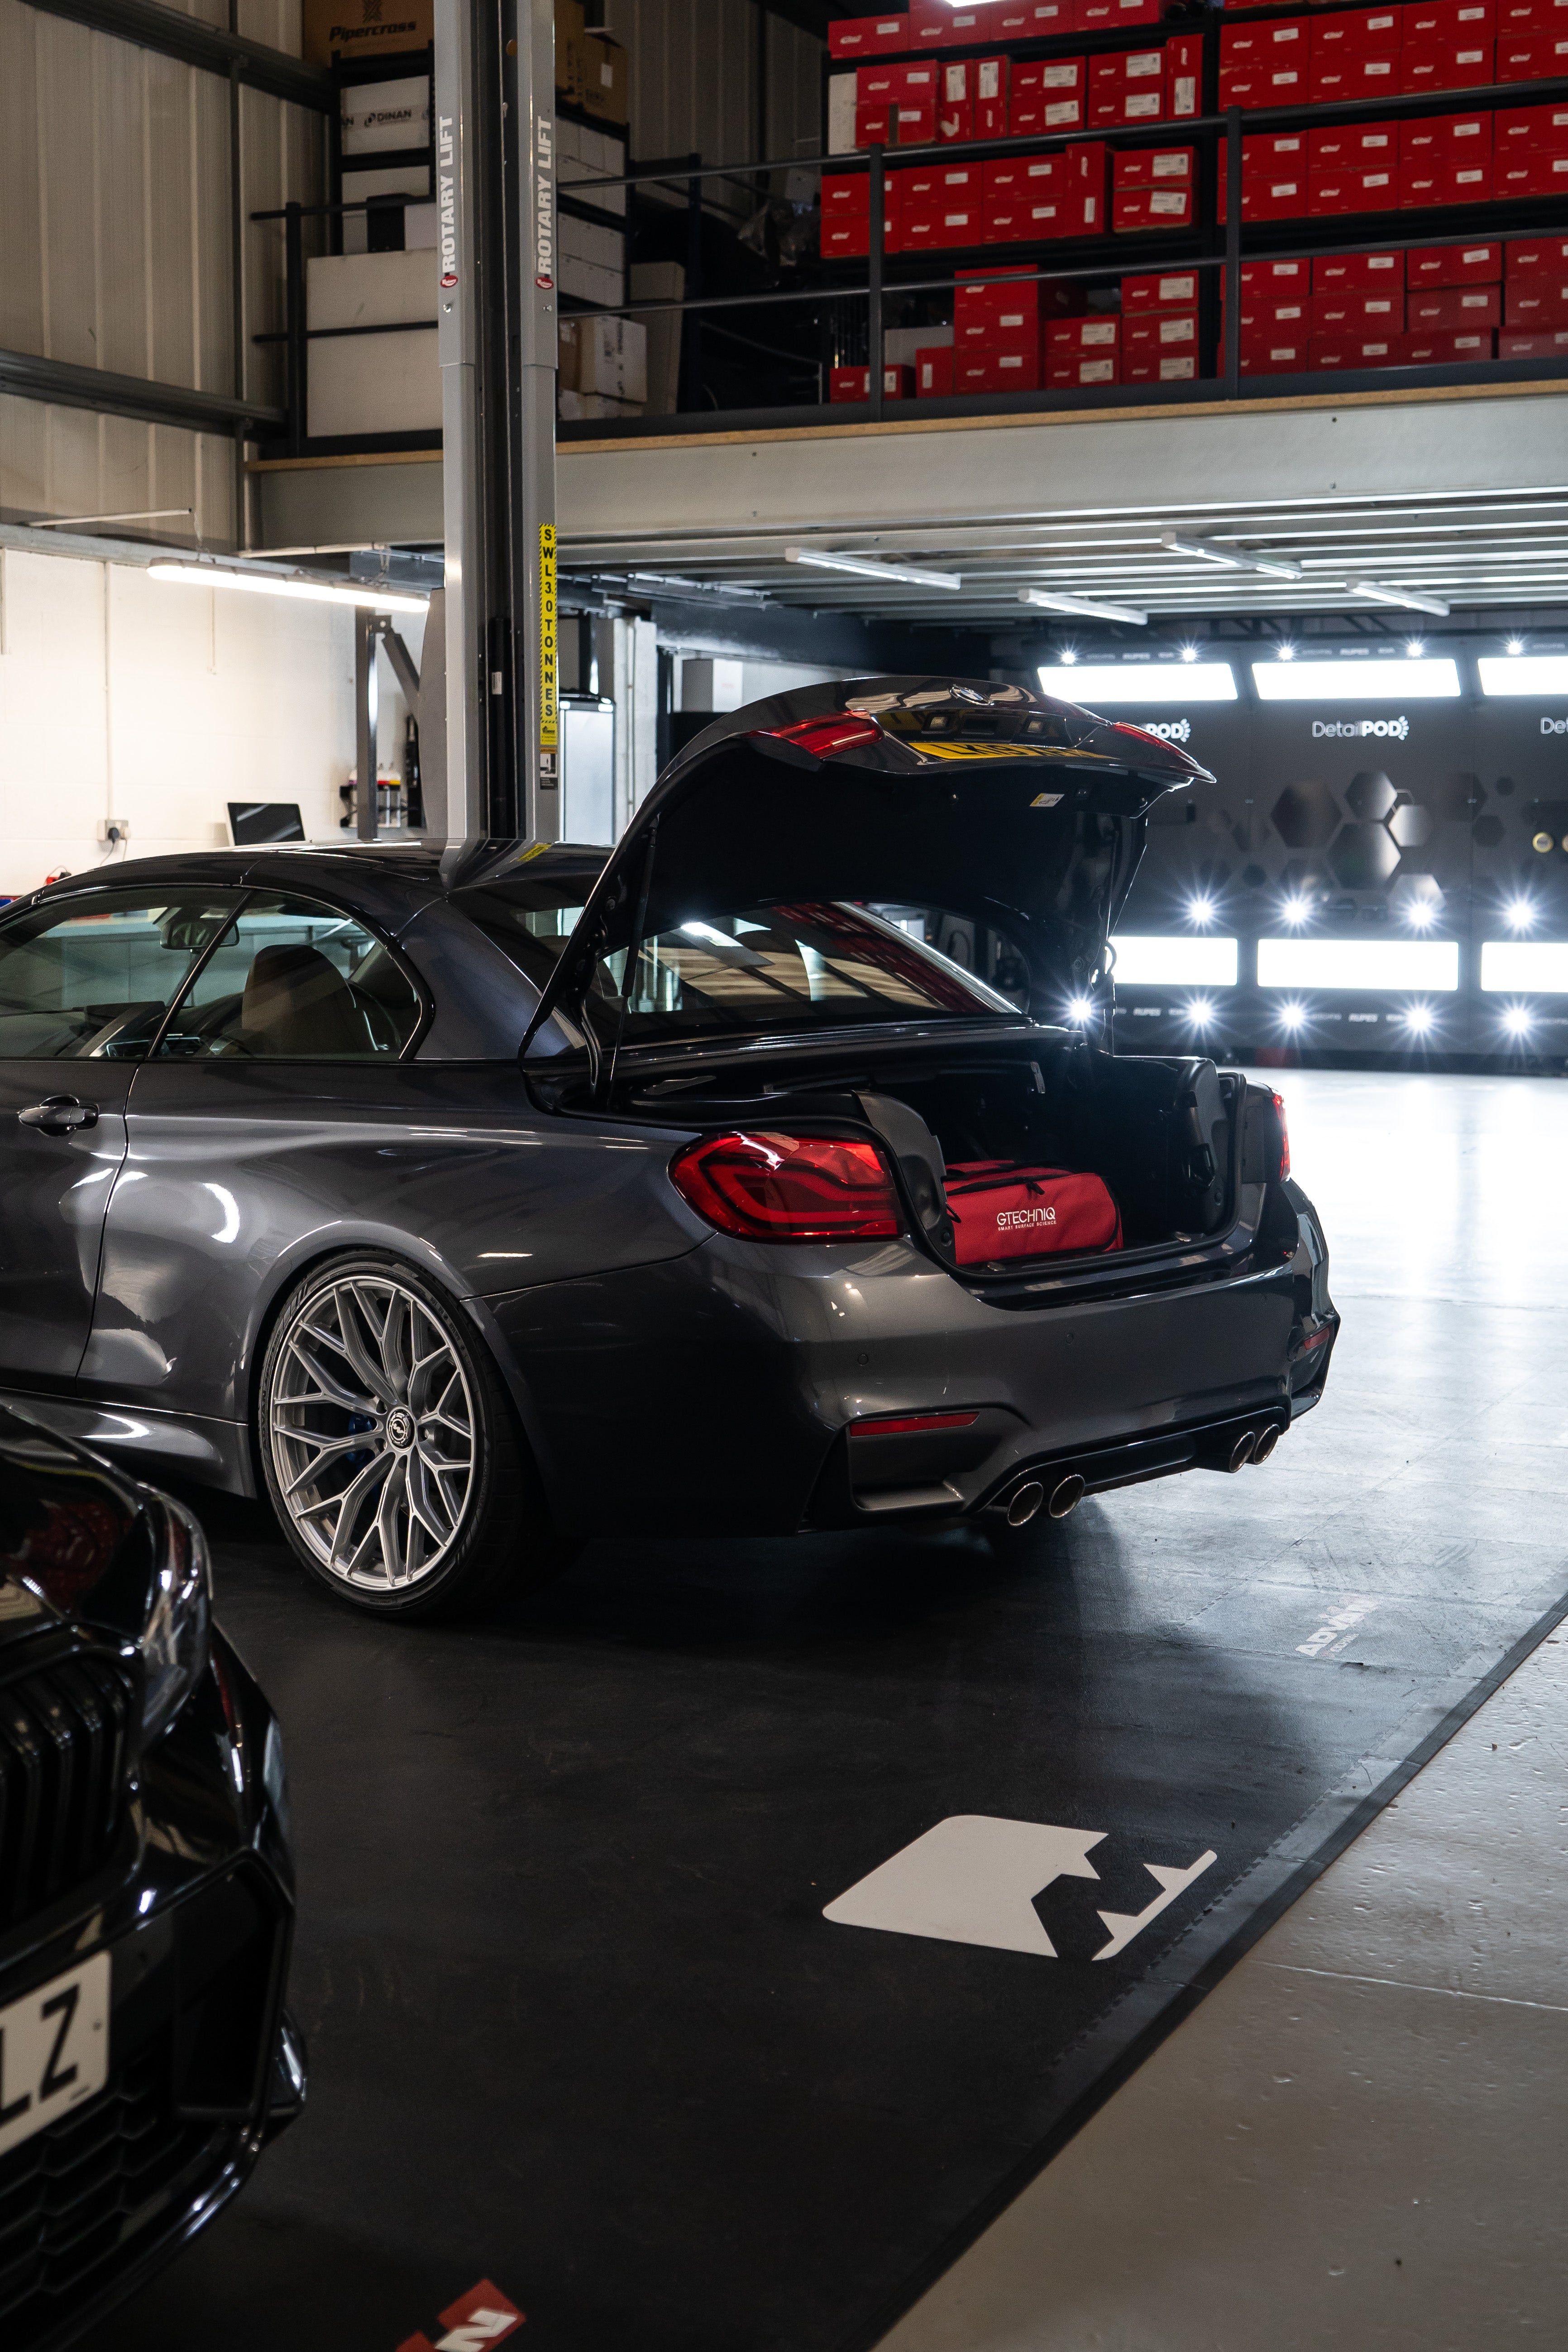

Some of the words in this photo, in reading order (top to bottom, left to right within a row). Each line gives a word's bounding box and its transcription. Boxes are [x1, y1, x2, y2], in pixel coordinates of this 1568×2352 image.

[329, 21, 417, 42] Pipercross
[440, 116, 453, 167] LIFT
[537, 115, 551, 169] LIFT
[440, 176, 455, 273] ROTARY
[537, 175, 552, 275] ROTARY
[543, 529, 554, 577] SWL
[545, 619, 554, 717] TONNES
[1312, 720, 1402, 737] DetailPOD
[1540, 717, 1568, 734] De
[997, 1207, 1056, 1226] GTECHNIQ
